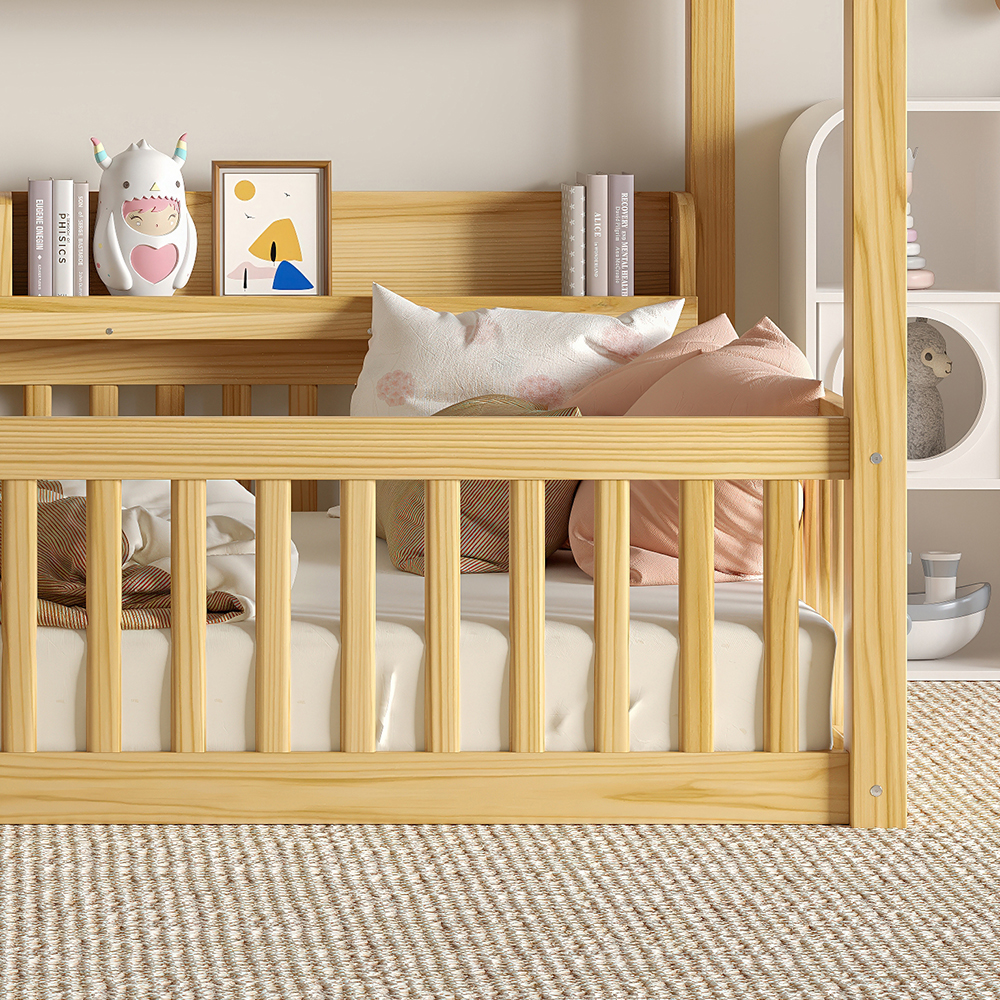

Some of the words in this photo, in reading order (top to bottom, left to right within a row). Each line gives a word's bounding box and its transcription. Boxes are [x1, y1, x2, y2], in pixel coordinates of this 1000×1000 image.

[621, 192, 629, 228] RECOVERY
[621, 241, 629, 268] MENTAL
[621, 269, 629, 296] HEALTH
